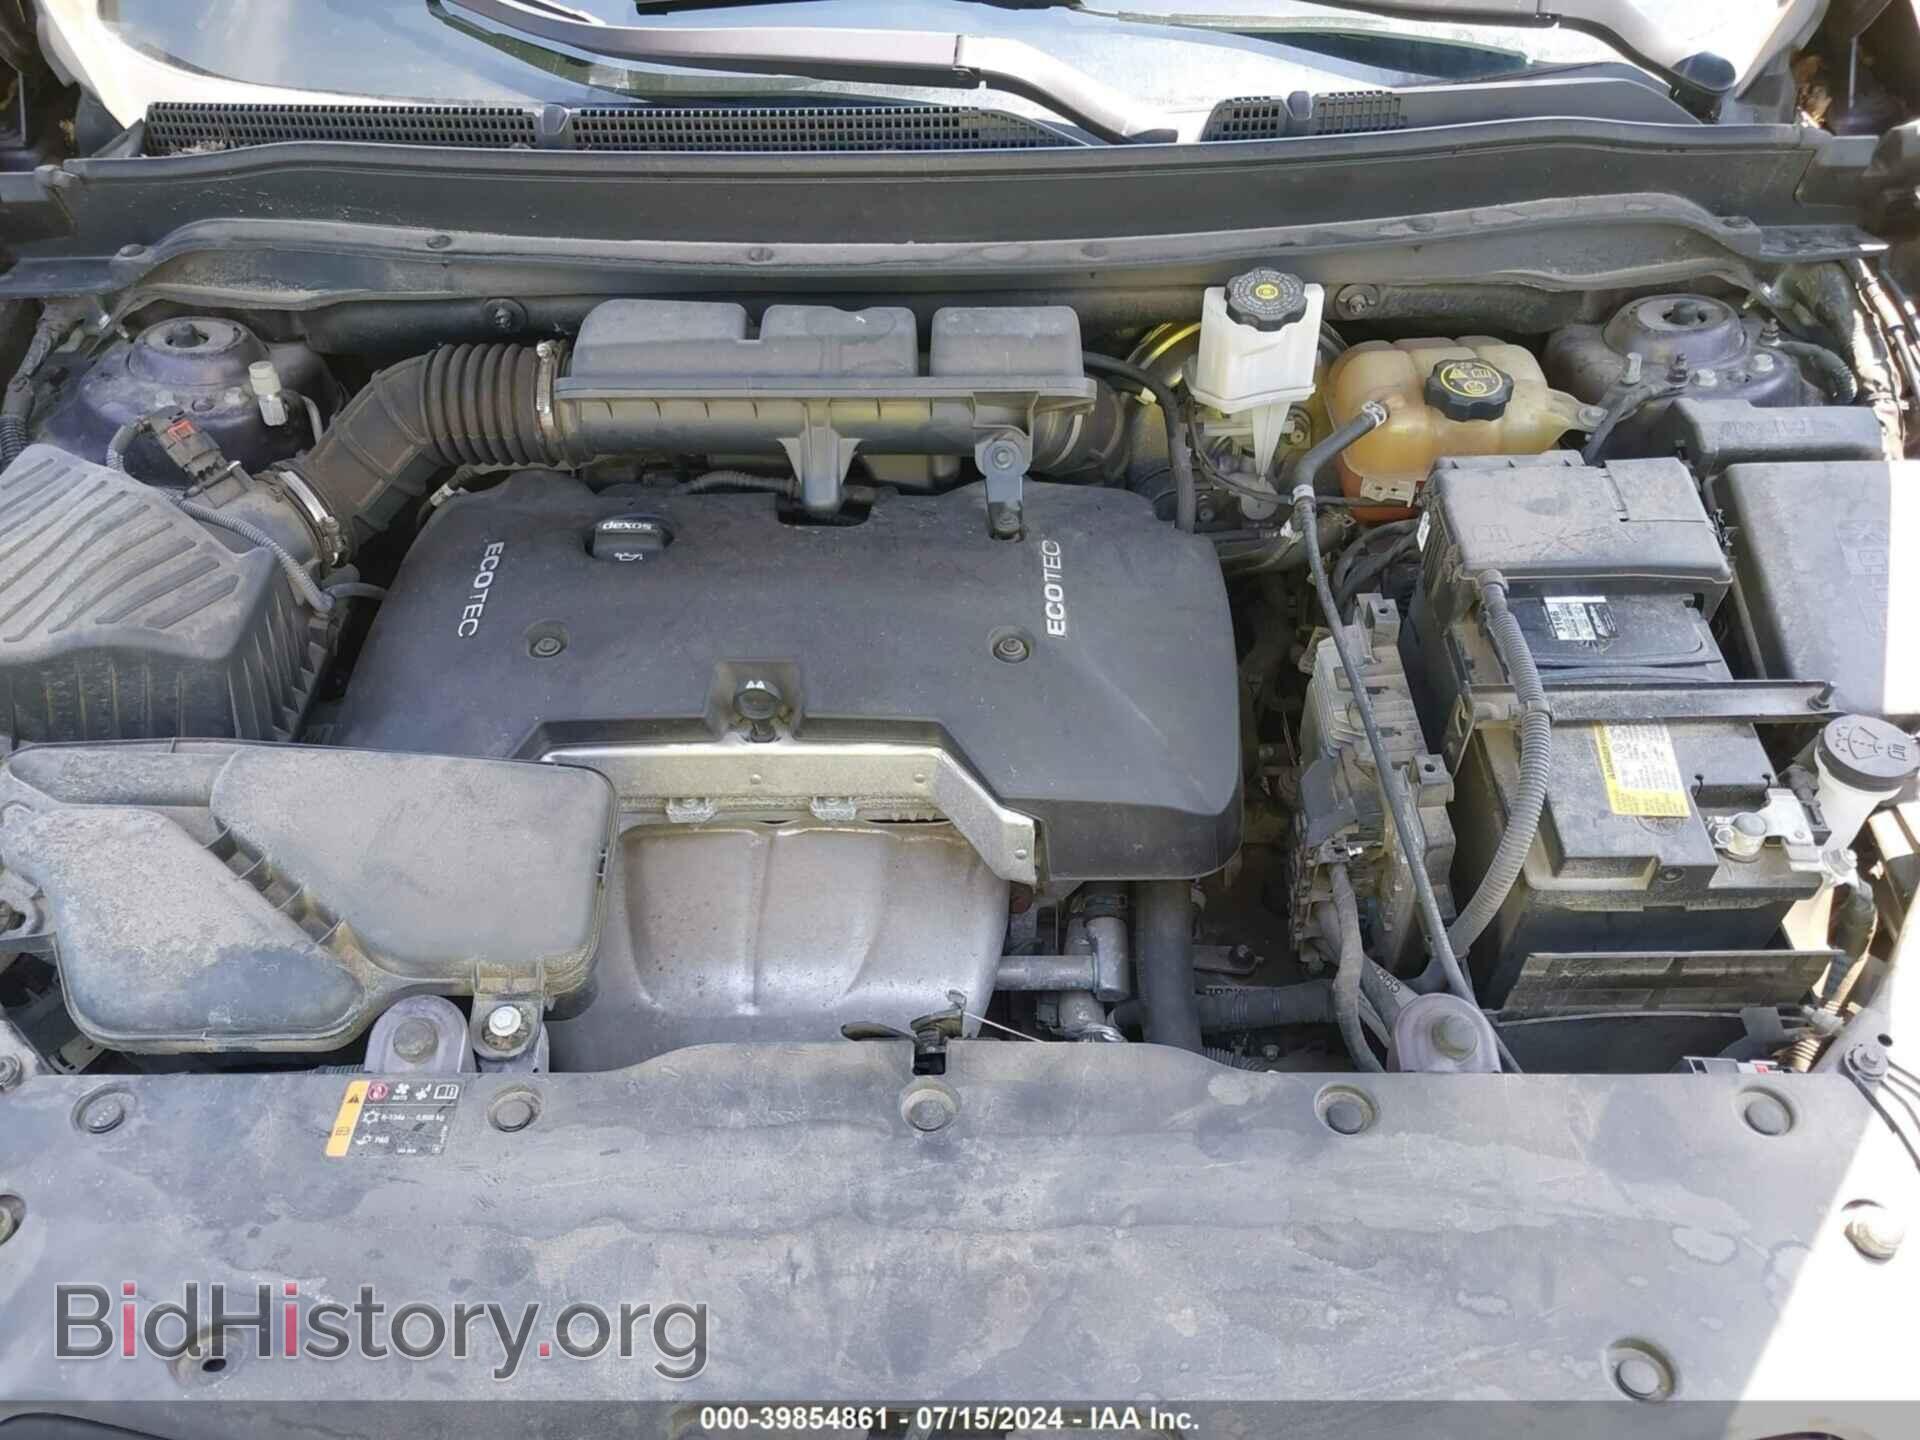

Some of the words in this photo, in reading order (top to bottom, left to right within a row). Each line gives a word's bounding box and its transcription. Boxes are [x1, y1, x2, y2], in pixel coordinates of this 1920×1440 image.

[602, 521, 652, 530] dexos
[457, 541, 505, 637] ECOTEC
[1041, 539, 1066, 636] ECOTEC
